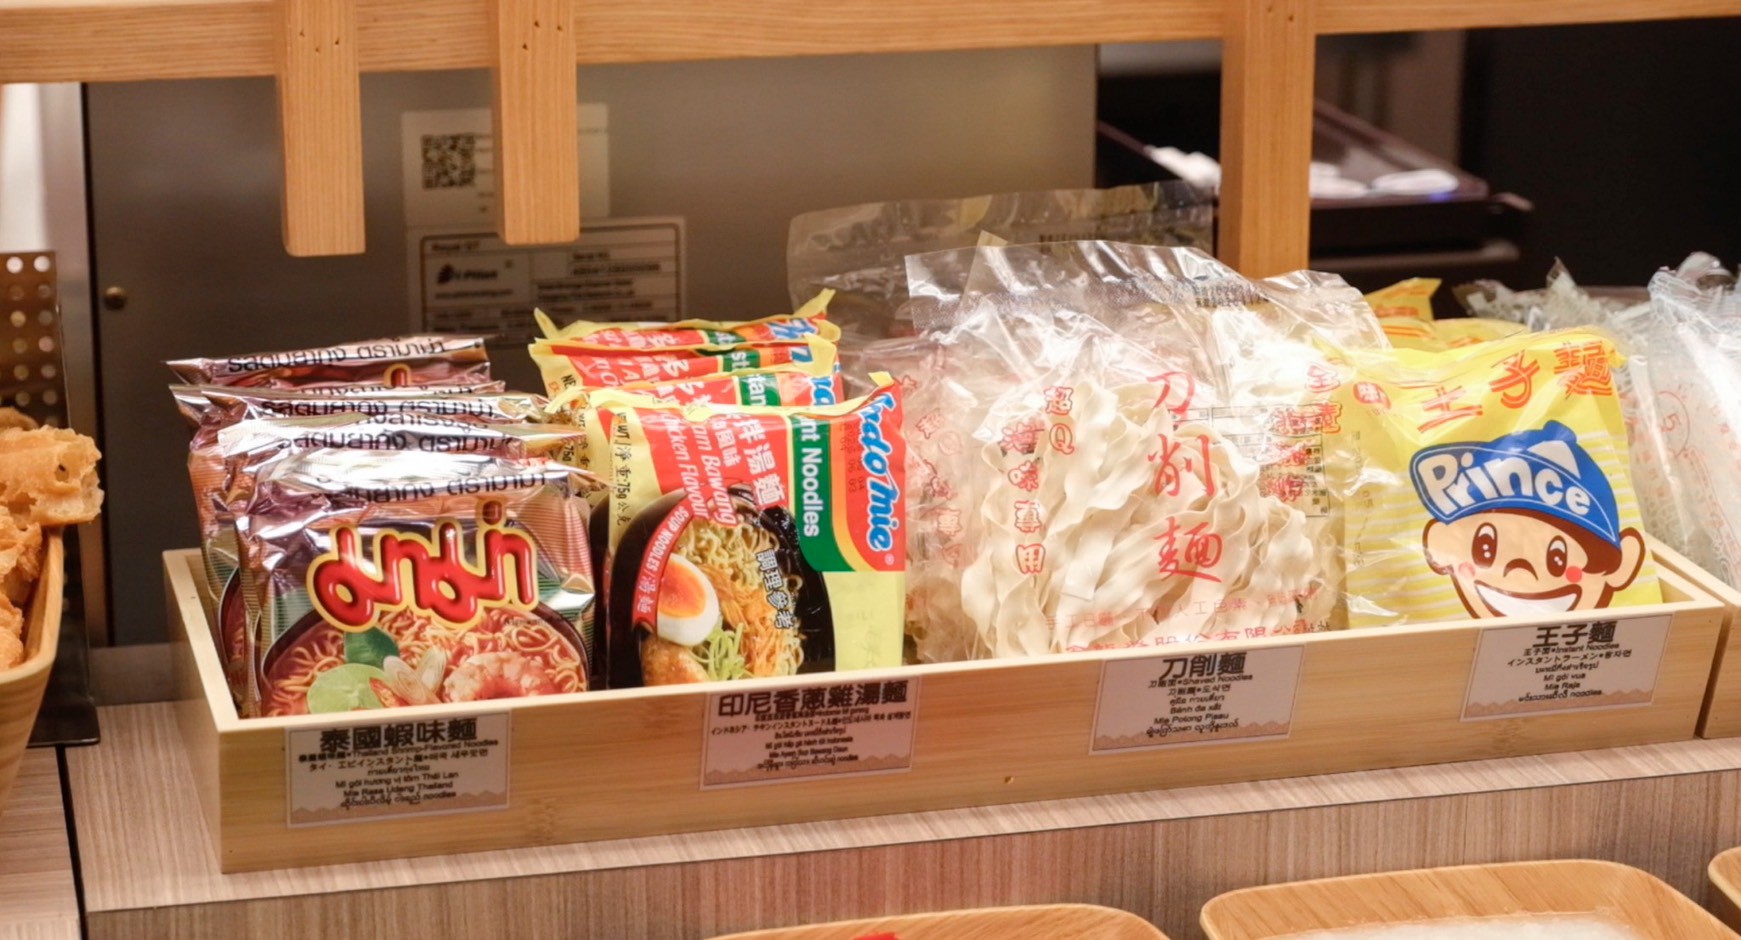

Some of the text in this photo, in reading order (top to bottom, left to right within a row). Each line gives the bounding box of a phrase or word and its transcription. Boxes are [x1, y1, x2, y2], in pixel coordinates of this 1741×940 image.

[677, 463, 710, 520] Flavour
[700, 454, 739, 526] Bawang
[799, 446, 821, 539] Noodles
[1147, 370, 1224, 583] 刀削麵
[1418, 450, 1592, 517] Prince
[667, 505, 690, 533] SOUP
[1532, 620, 1617, 648] 王子麵
[1158, 652, 1247, 680] 刀削麵
[320, 716, 477, 752] 泰國蝦味麵
